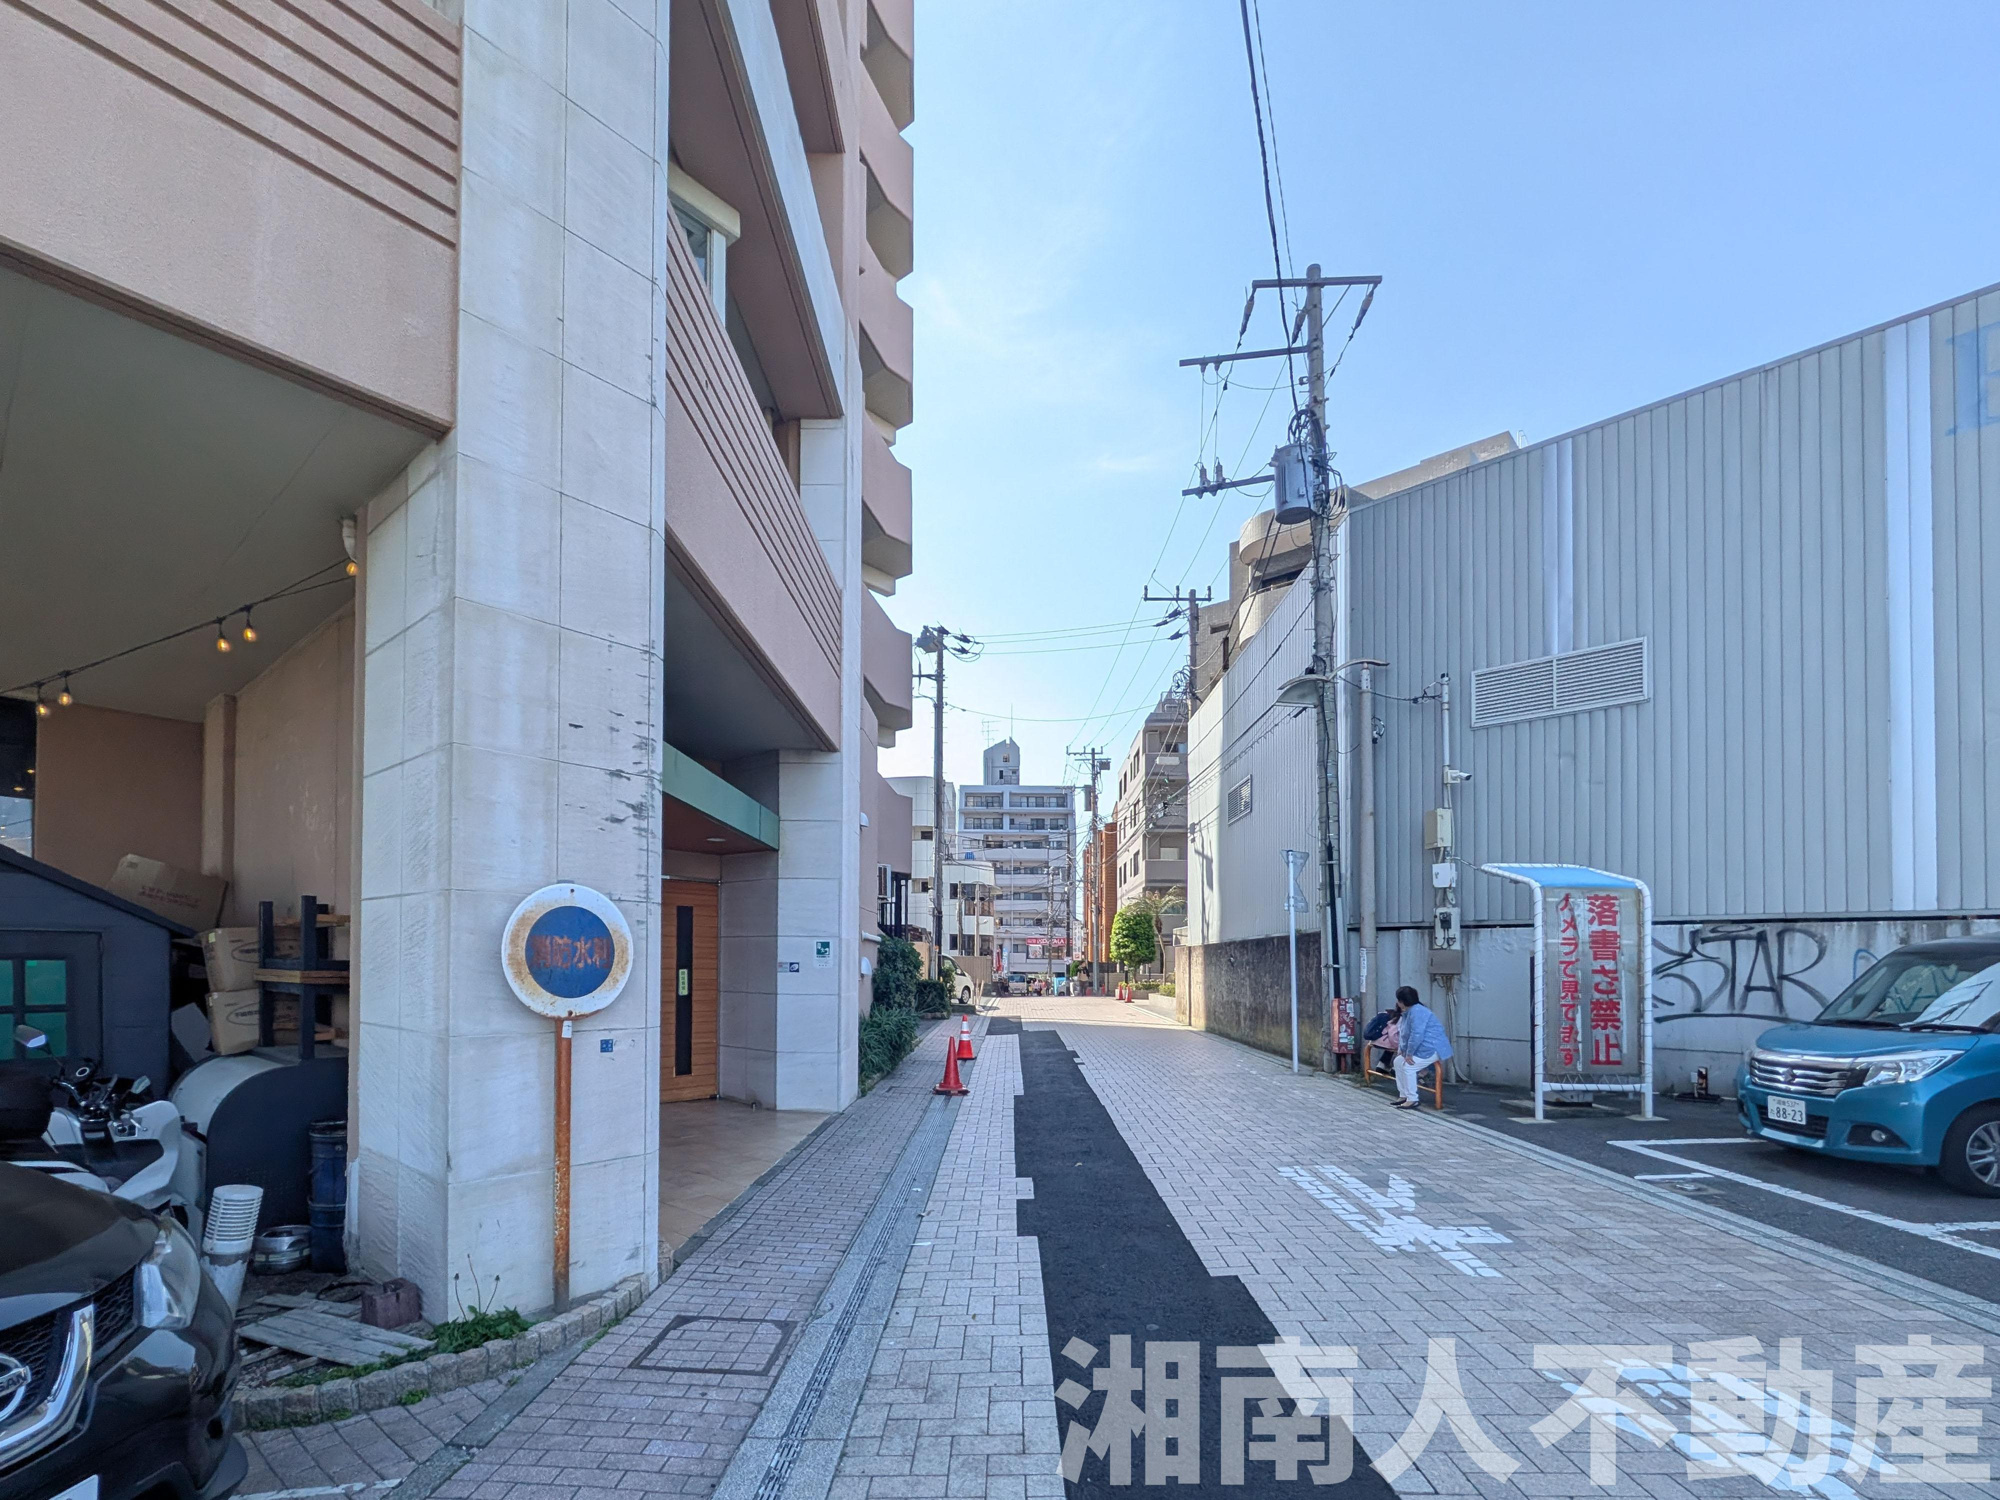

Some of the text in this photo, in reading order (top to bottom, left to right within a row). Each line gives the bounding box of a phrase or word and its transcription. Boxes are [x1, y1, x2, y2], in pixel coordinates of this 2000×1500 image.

[531, 934, 612, 970] 消防水利
[1776, 1107, 1803, 1122] 88-23
